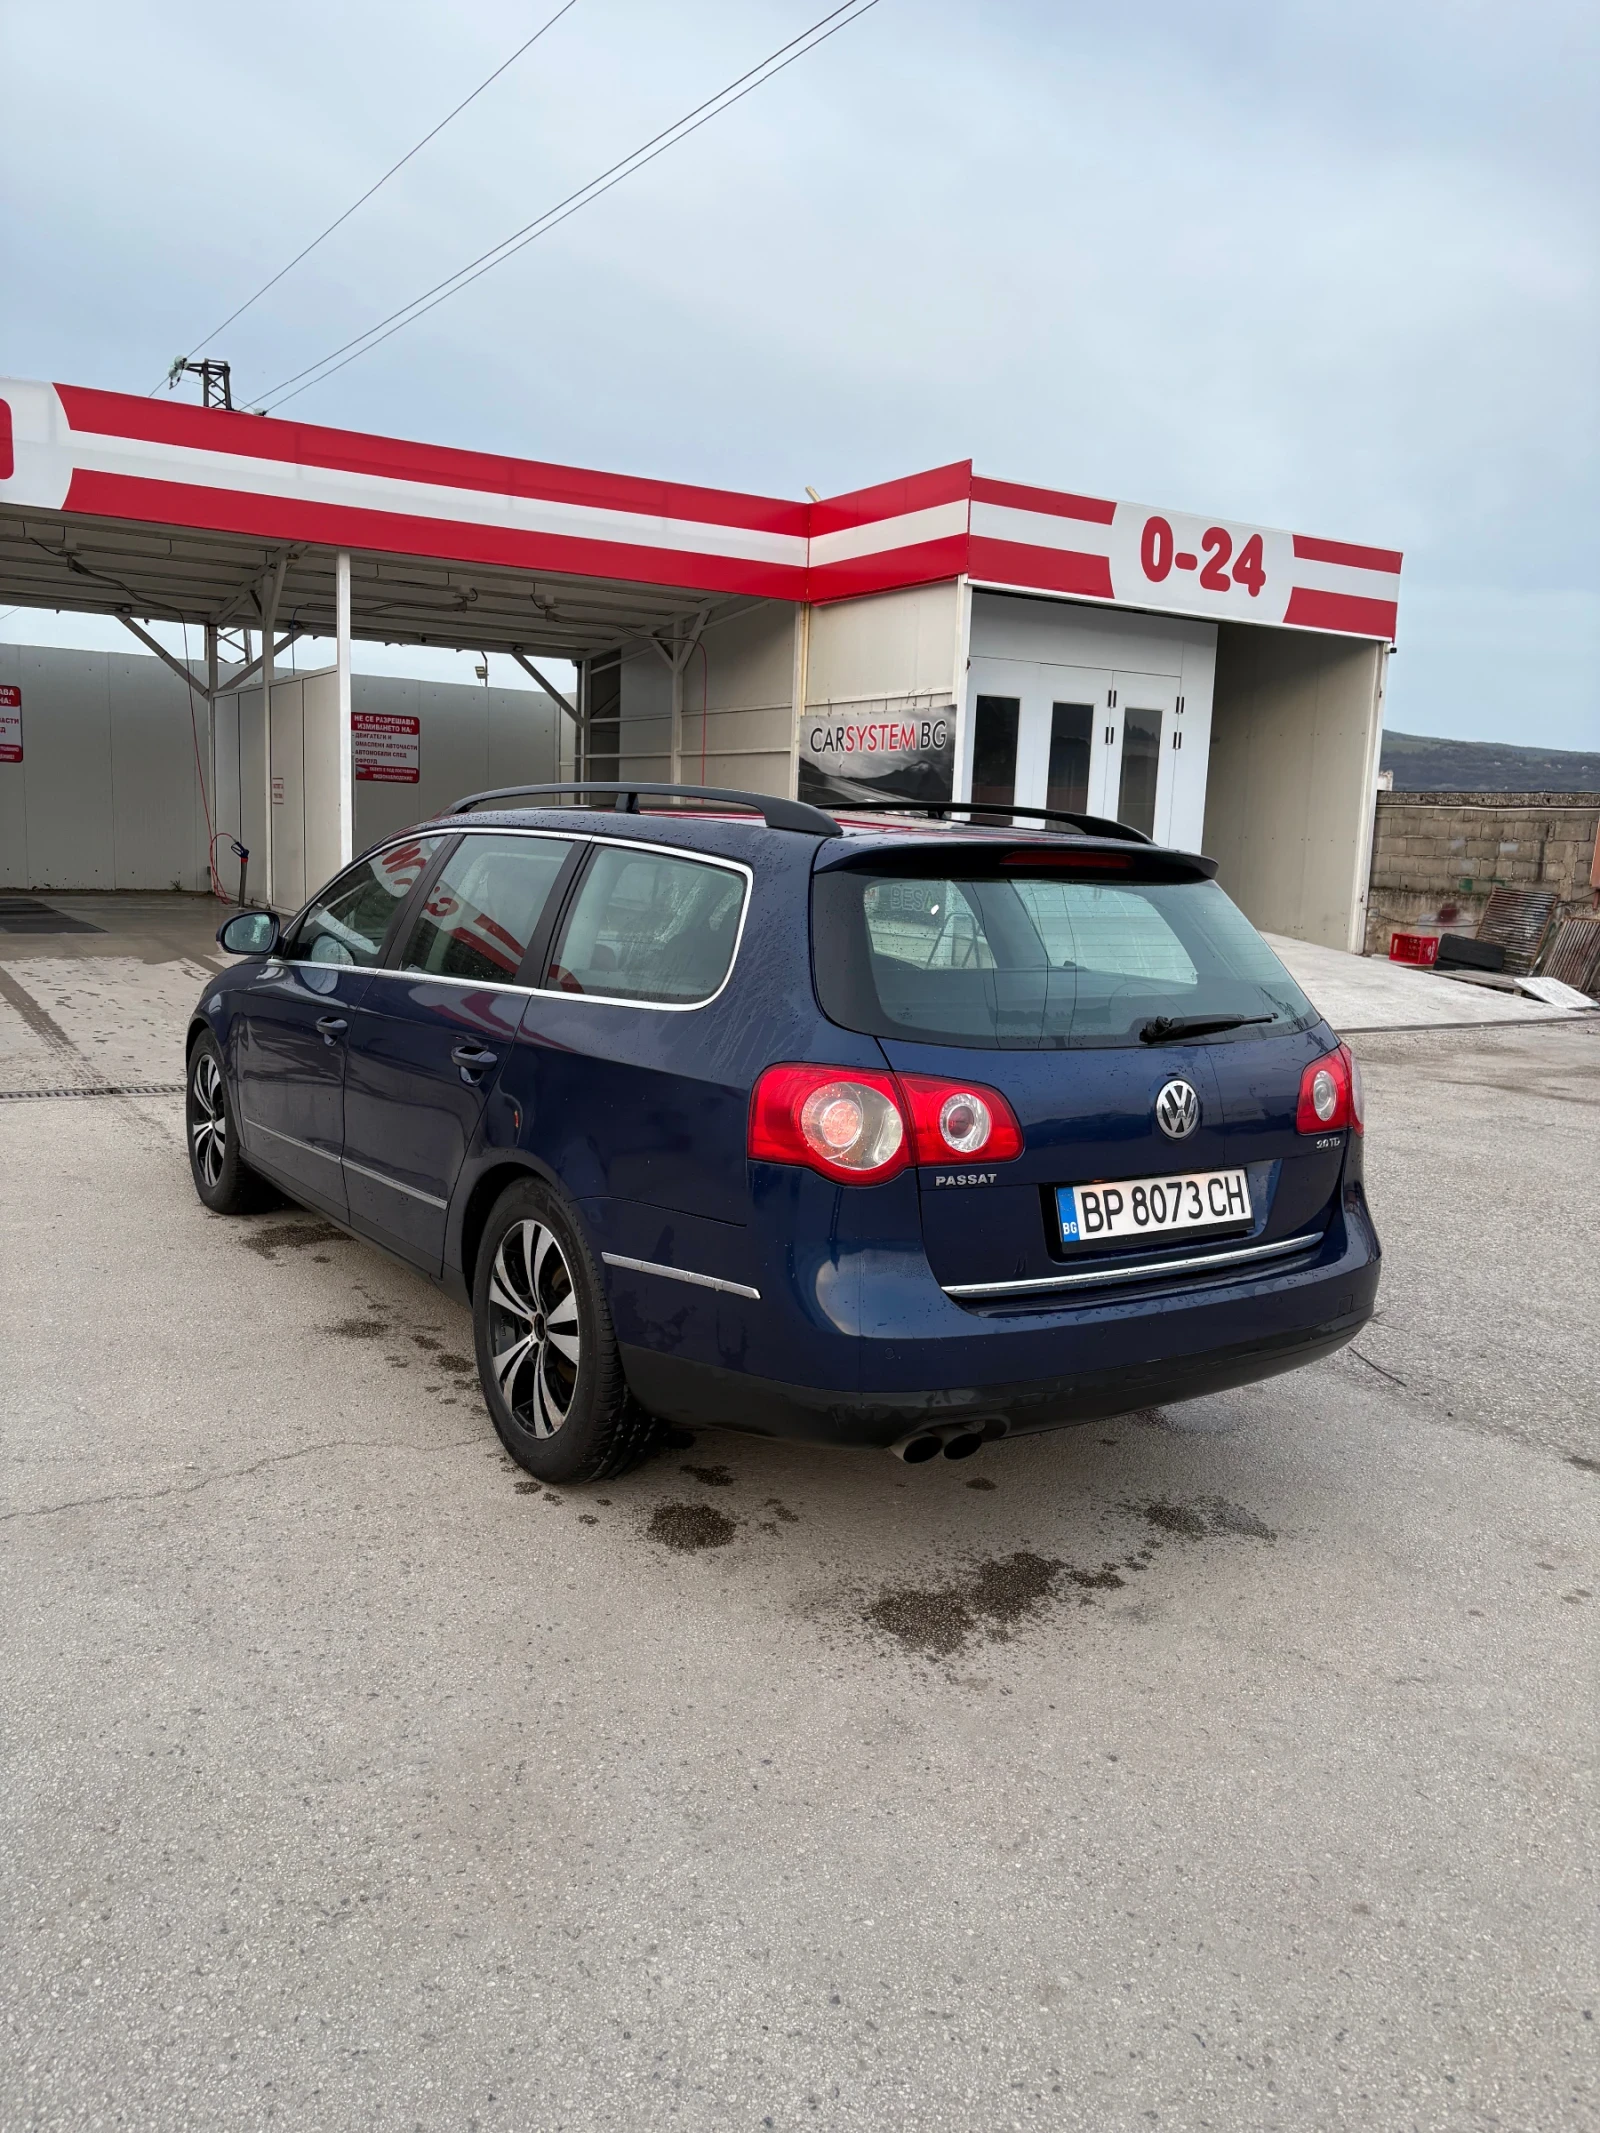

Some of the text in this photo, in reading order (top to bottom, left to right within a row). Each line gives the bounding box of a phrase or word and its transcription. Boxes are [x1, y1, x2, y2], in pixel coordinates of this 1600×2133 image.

[1141, 516, 1266, 597] 0-24
[357, 723, 400, 732] ИЗМИВАНЕТО
[375, 716, 415, 726] РАЗРЕШАВА
[935, 1173, 997, 1186] PASSAT
[1081, 1175, 1246, 1233] BP 8073 CH
[1062, 1222, 1078, 1235] BG
